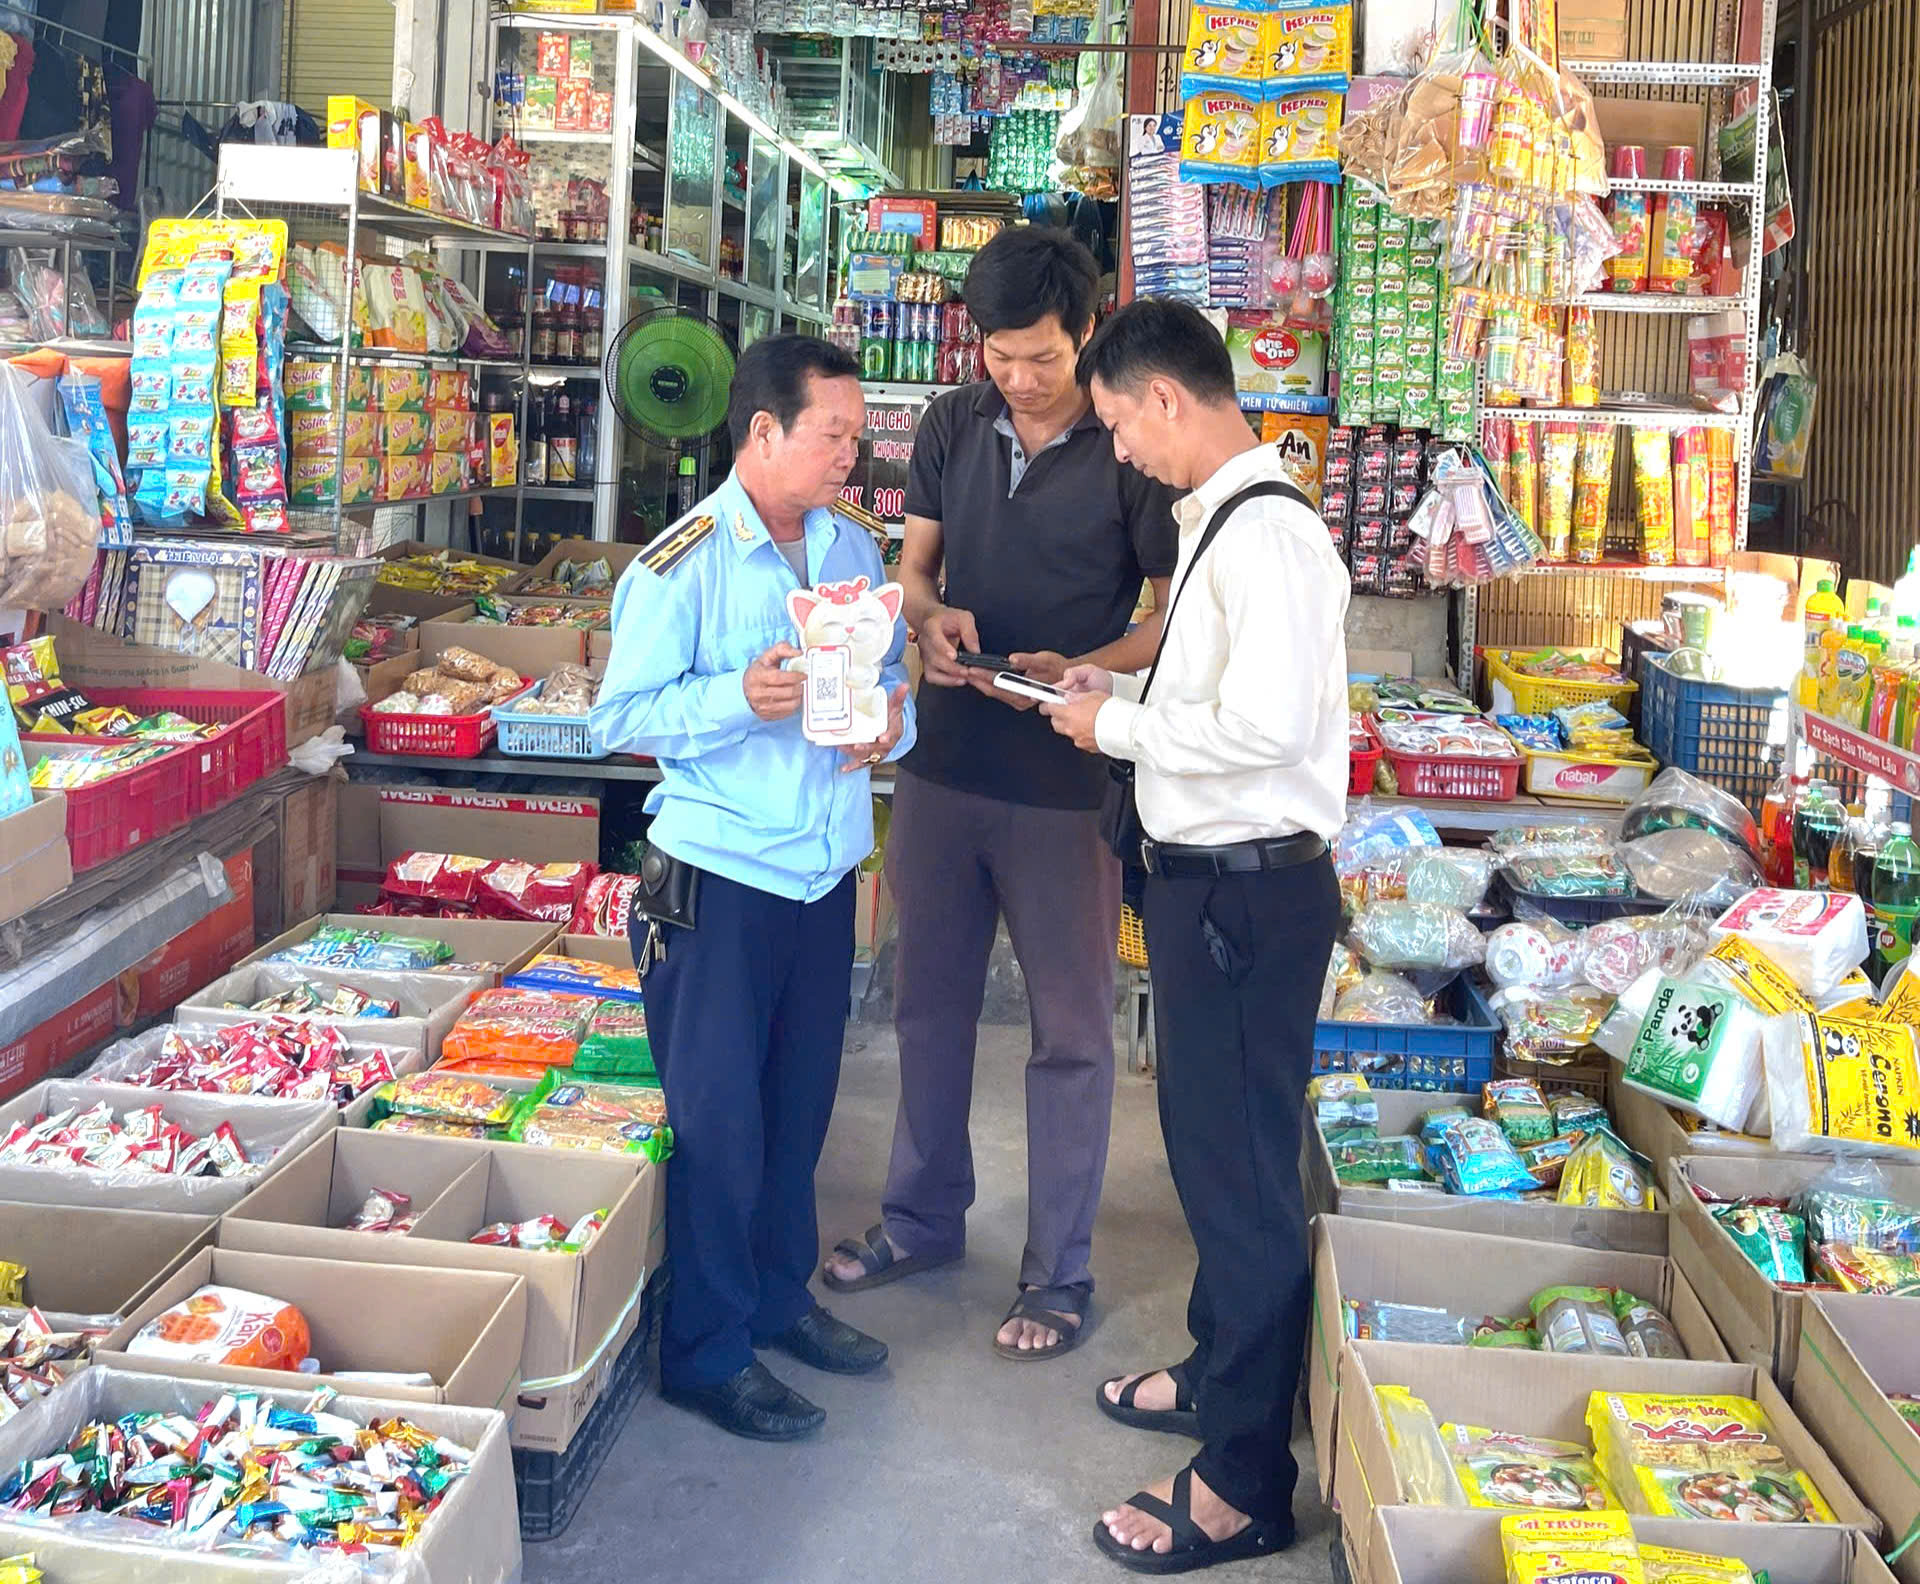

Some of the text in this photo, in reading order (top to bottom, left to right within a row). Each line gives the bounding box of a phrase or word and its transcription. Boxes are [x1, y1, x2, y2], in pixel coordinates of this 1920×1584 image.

[1254, 338, 1284, 354] One
[1267, 348, 1296, 360] One
[1240, 396, 1262, 409] MEN
[867, 410, 885, 432] TẠI
[1276, 431, 1311, 460] An
[873, 487, 905, 517] 300
[40, 694, 88, 717] CHIN-SU
[1812, 724, 1821, 740] 2X
[1822, 728, 1841, 749] Sạch
[1841, 737, 1856, 756] Sâu
[1881, 755, 1897, 776] Lâu
[1642, 987, 1675, 1043] Panda
[1893, 1057, 1905, 1097] NAPKIN
